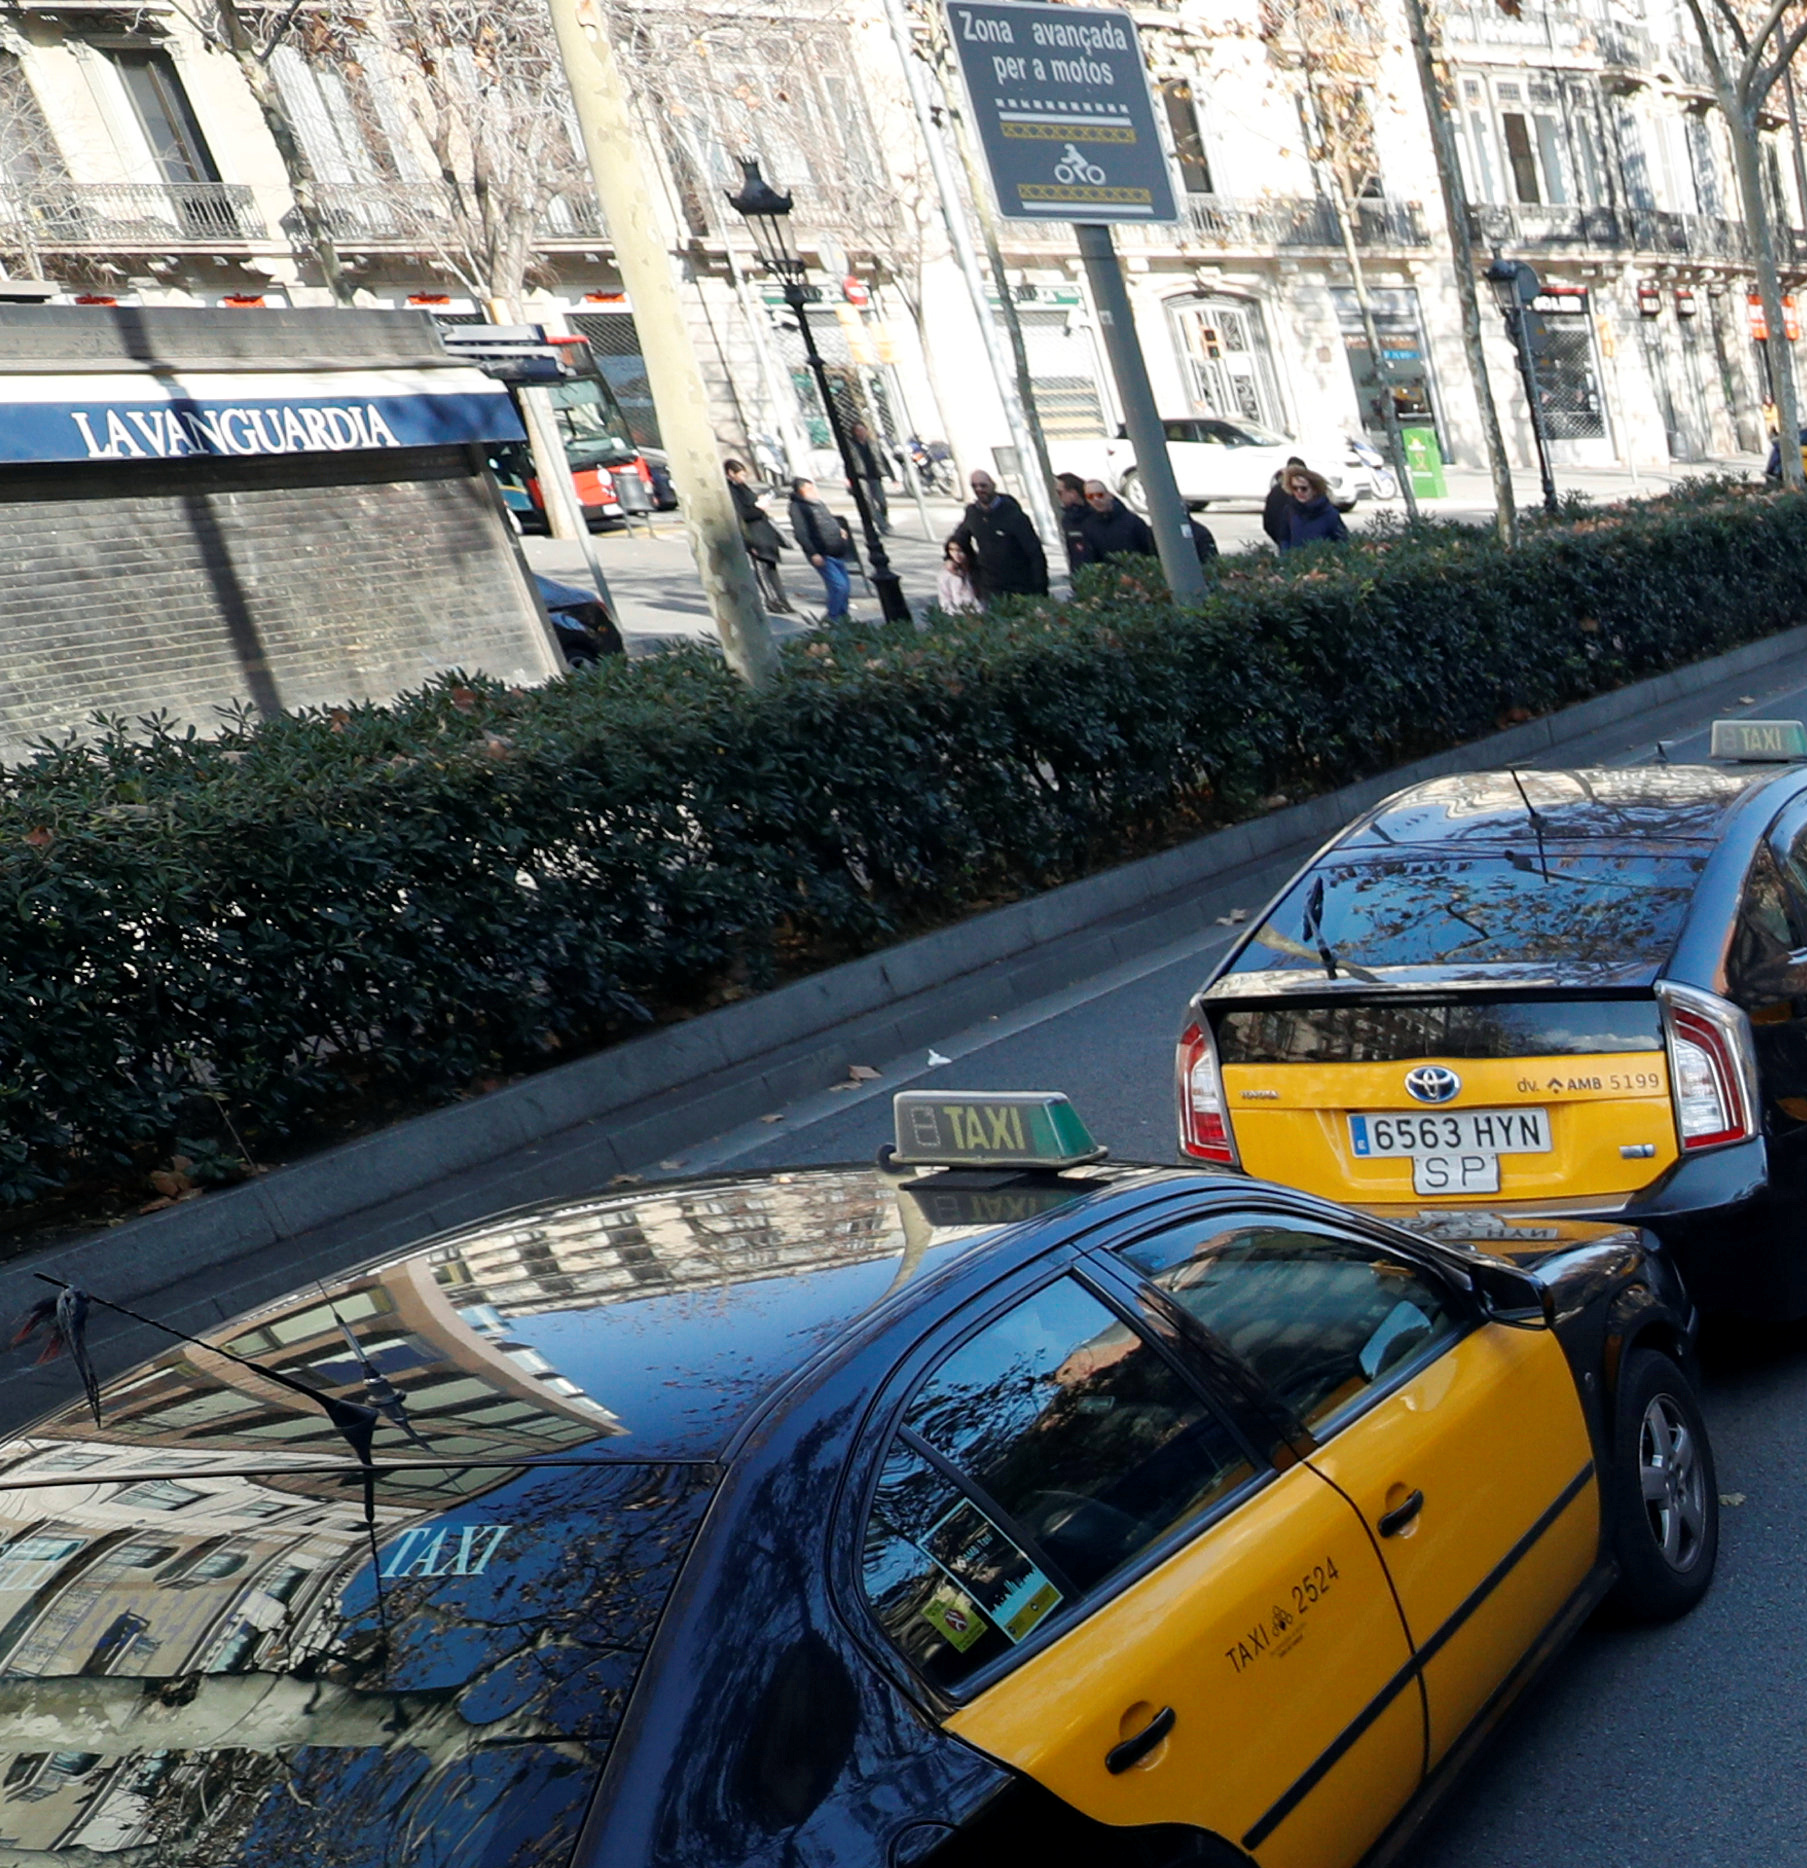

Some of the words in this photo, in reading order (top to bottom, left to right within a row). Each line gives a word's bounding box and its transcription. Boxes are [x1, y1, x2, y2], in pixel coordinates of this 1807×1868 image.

[958, 10, 1014, 44] Zona
[1031, 20, 1128, 56] avançada
[992, 54, 1026, 85] per
[1032, 58, 1047, 81] a
[1050, 56, 1114, 85] motos
[1740, 729, 1782, 750] TAXI
[1517, 1076, 1539, 1093] dv.
[1567, 1076, 1601, 1091] AMB
[1610, 1073, 1660, 1090] 5199
[943, 1106, 1026, 1150] TAXI
[1373, 1118, 1462, 1151] 6563
[1473, 1114, 1540, 1148] HYN
[1425, 1157, 1486, 1188] SP
[379, 1524, 512, 1578] TAXI
[1225, 1623, 1270, 1674] TAXI
[1291, 1555, 1339, 1614] 2524
